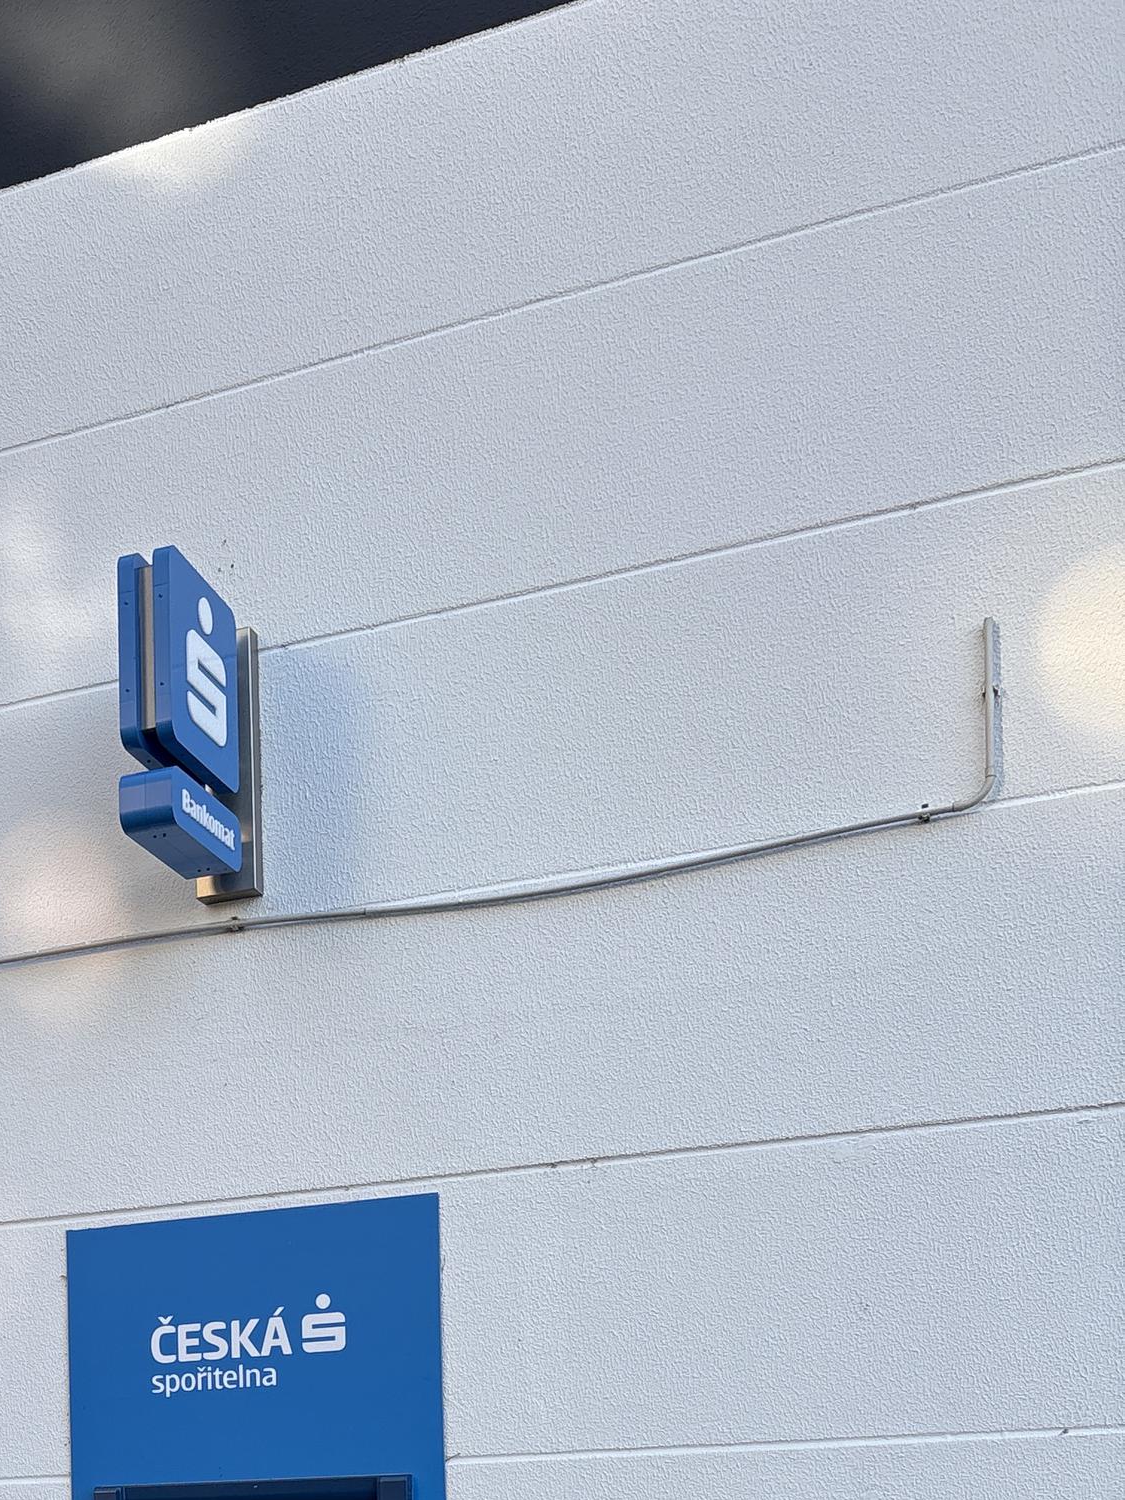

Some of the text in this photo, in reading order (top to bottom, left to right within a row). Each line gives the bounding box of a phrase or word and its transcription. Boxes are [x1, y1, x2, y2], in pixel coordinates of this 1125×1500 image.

[181, 788, 236, 851] Bankomat
[150, 1306, 293, 1365] ČESKÁ
[151, 1364, 278, 1398] spořitelna
